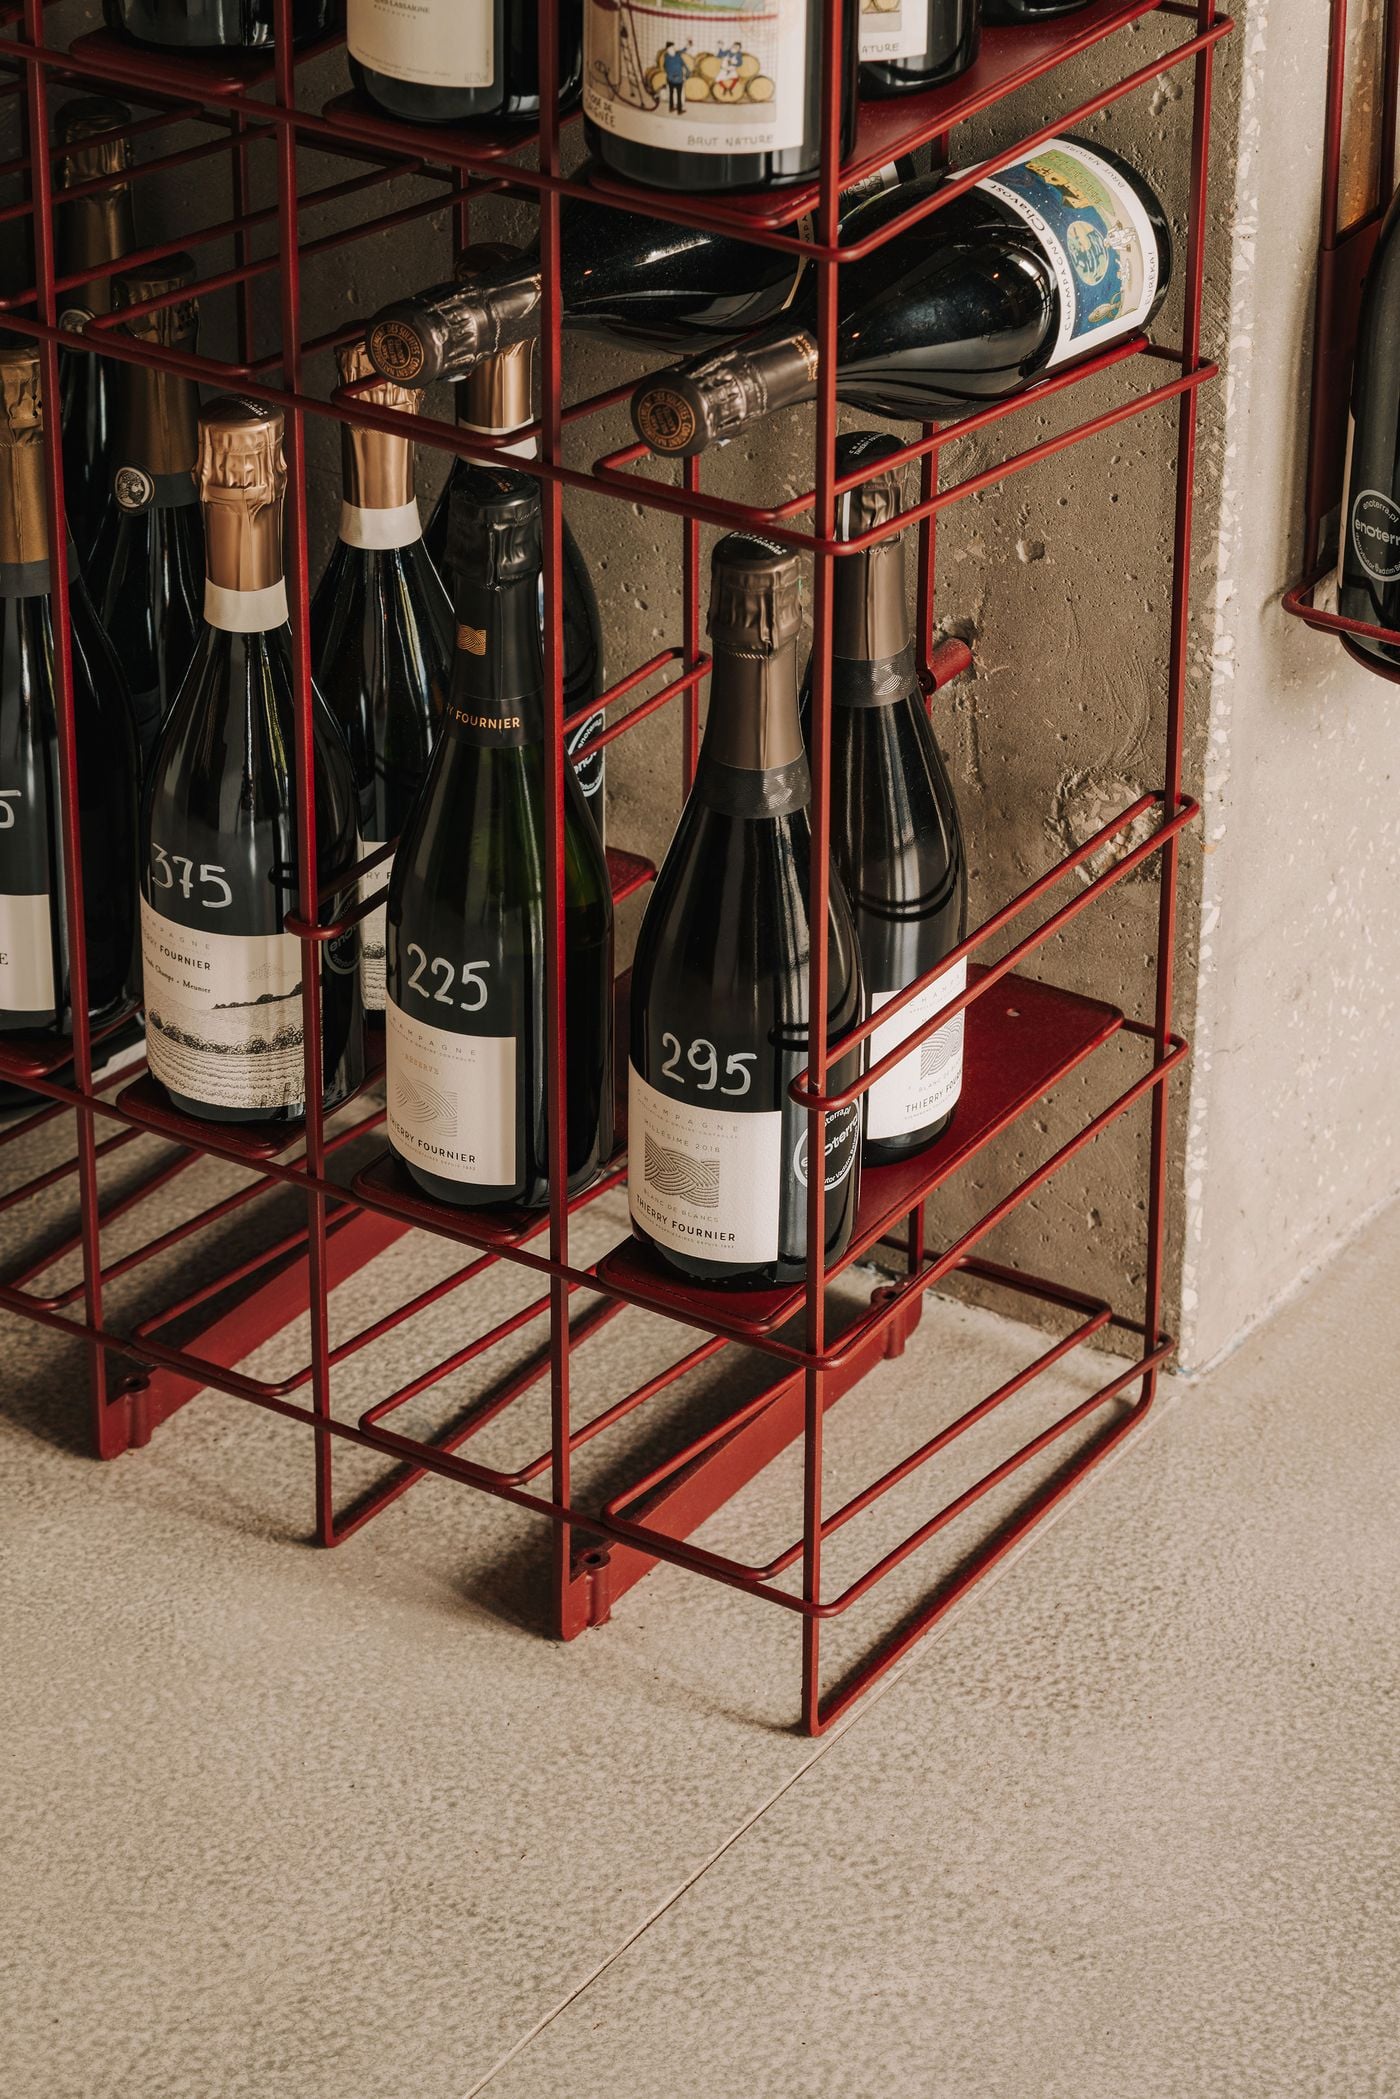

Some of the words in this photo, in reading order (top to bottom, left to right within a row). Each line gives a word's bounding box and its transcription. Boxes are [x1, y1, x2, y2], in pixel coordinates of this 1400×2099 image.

[862, 43, 899, 54] ATURE
[687, 135, 718, 146] BRUT
[725, 134, 774, 147] NATURE
[990, 183, 1046, 232] Chavost
[1045, 236, 1073, 332] CHAMPAGNE
[1354, 519, 1400, 547] enoterr
[455, 710, 520, 730] FOURNIER
[151, 842, 233, 909] 375
[159, 944, 211, 971] FOURNIER
[407, 942, 491, 1012] 225
[661, 1031, 758, 1096] 295
[417, 1139, 476, 1163] FOURNIER
[636, 1194, 668, 1225] THIERRY
[671, 1220, 736, 1242] FOURNIER
